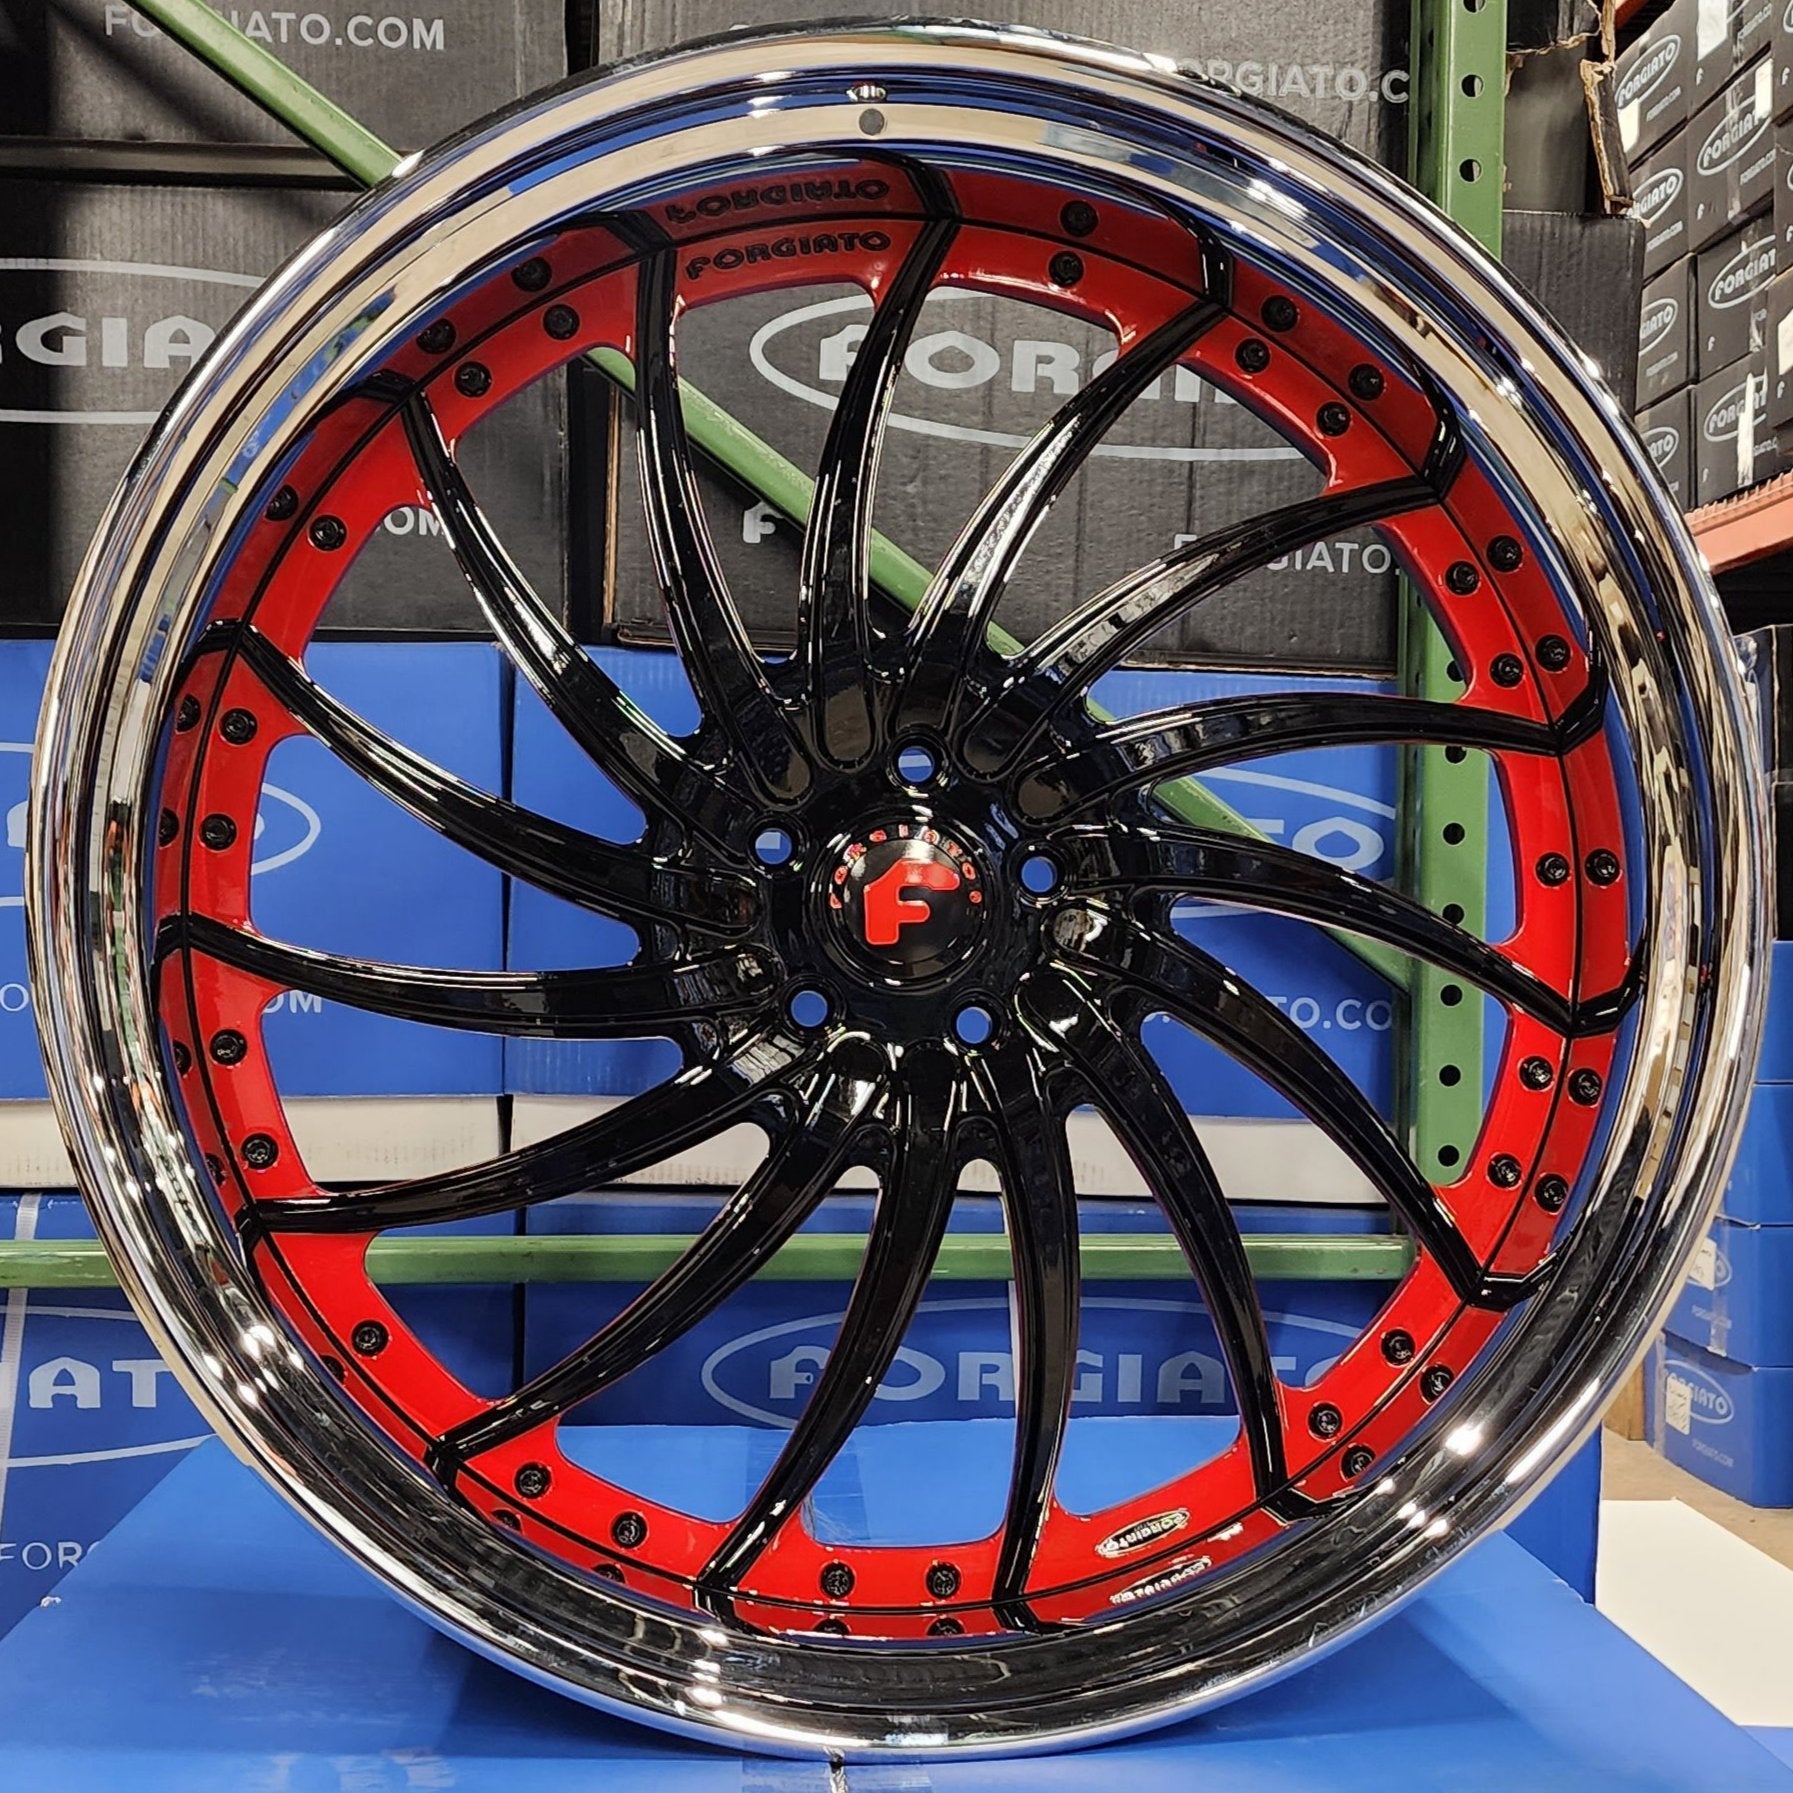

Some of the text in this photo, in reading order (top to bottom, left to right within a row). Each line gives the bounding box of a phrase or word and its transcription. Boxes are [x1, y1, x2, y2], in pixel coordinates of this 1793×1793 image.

[104, 7, 445, 50] FOATO.COM
[1617, 42, 1676, 108] FORGIATO
[685, 231, 892, 280] FORGIATO
[0, 311, 216, 369] GIA
[374, 506, 446, 537] OM
[863, 857, 961, 945] F
[0, 1541, 101, 1570] FOR
